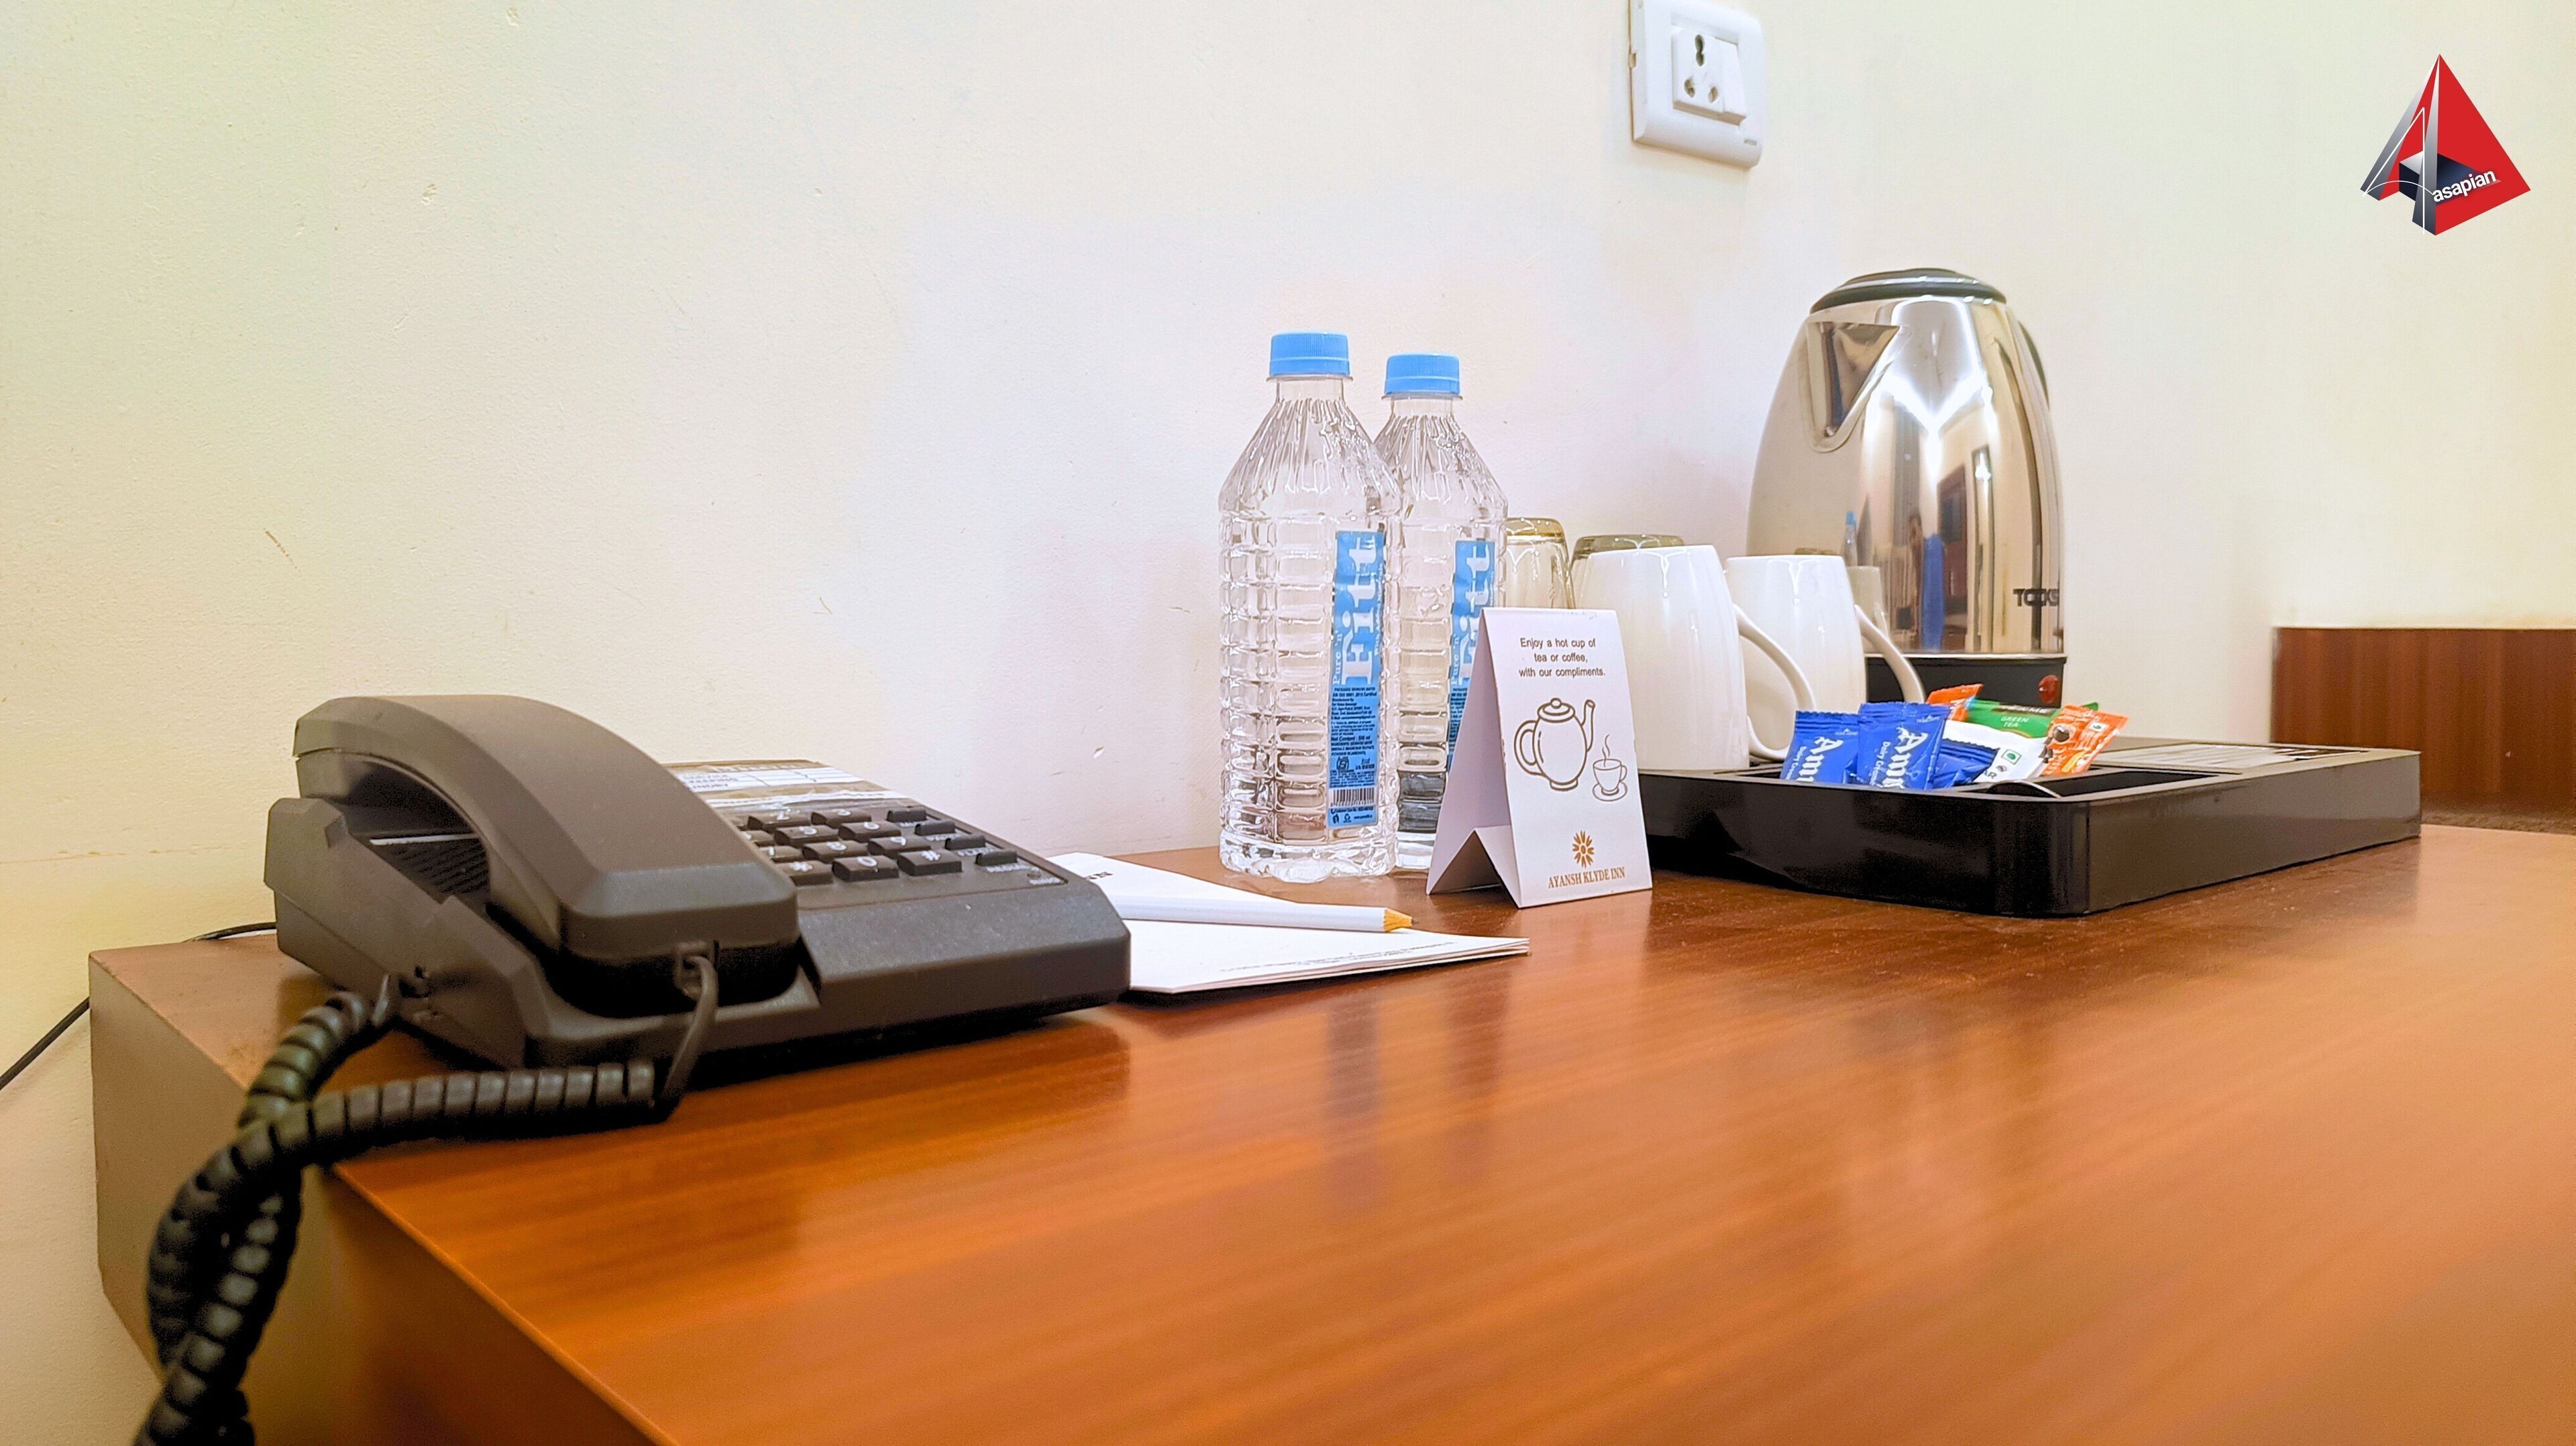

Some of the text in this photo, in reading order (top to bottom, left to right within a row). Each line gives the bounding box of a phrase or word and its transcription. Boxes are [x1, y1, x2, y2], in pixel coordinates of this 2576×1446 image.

[1342, 535, 1377, 685] Fitt
[1520, 638, 1543, 649] Enjoy
[1555, 638, 1568, 647] hot
[1571, 639, 1585, 649] cup
[1589, 638, 1596, 647] of
[1534, 653, 1588, 663] tea or coffee,
[1332, 652, 1342, 685] Pure
[1519, 667, 1536, 677] with
[1556, 667, 1605, 679] compliments.
[1548, 867, 1625, 889] AYANSH KLYDE INN
